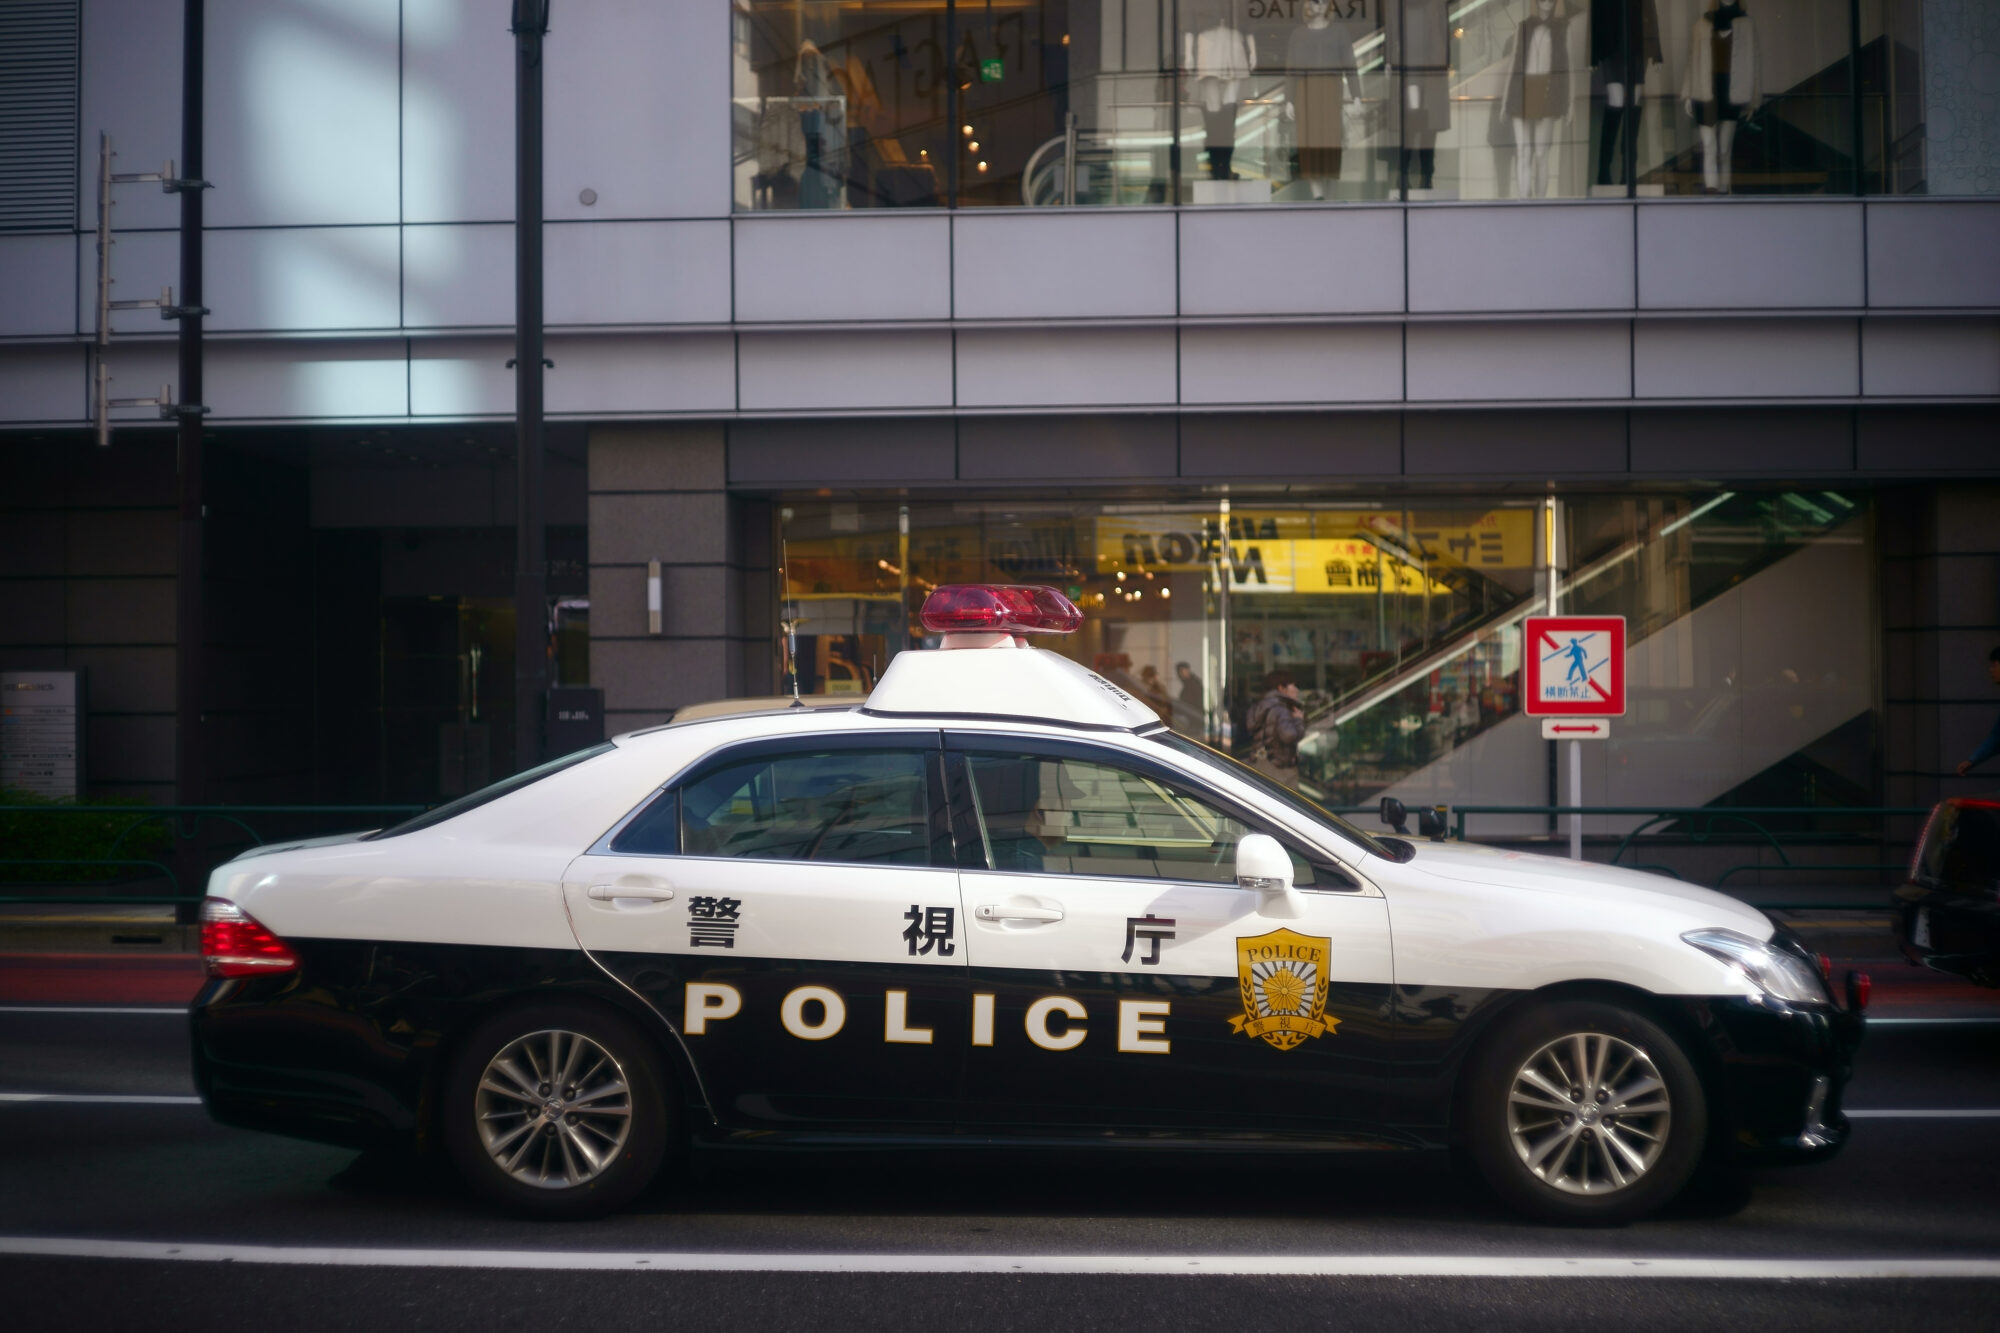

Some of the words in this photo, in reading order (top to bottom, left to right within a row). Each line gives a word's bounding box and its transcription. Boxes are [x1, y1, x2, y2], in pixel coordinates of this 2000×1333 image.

[1544, 685, 1591, 700] 横断禁止
[686, 895, 1177, 966] 警視庁
[1246, 944, 1322, 963] POLICE
[683, 981, 1172, 1055] POLICE
[1252, 1015, 1318, 1036] 警視庁
